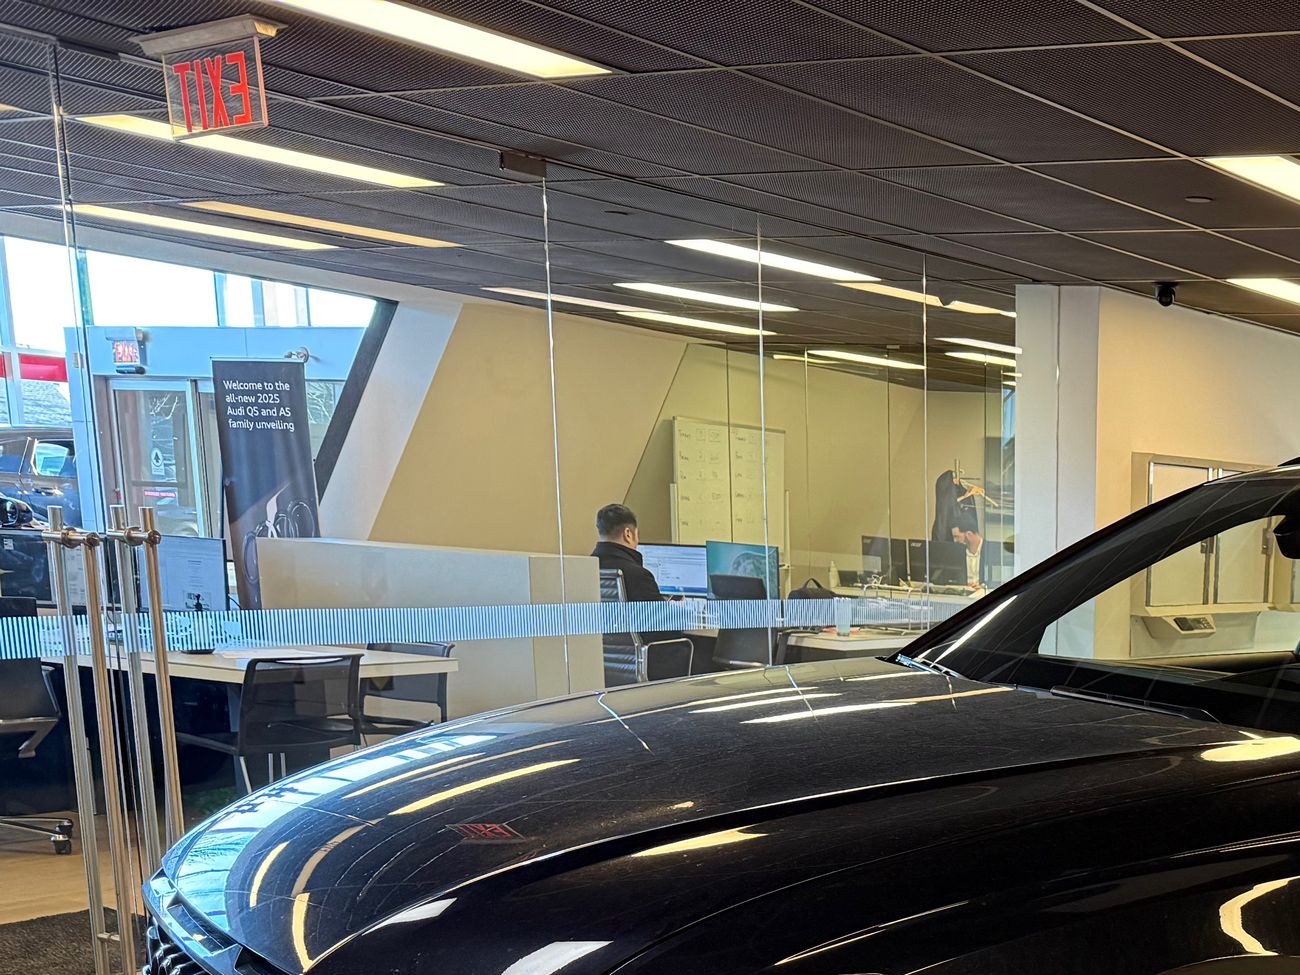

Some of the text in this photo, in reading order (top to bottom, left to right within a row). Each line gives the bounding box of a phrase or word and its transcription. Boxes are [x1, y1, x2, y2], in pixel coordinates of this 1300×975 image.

[223, 380, 290, 391] Welcome to the
[225, 393, 280, 403] all-new 2025
[227, 406, 245, 416] Audi
[261, 407, 277, 416] and
[228, 419, 295, 432] family unveiling
